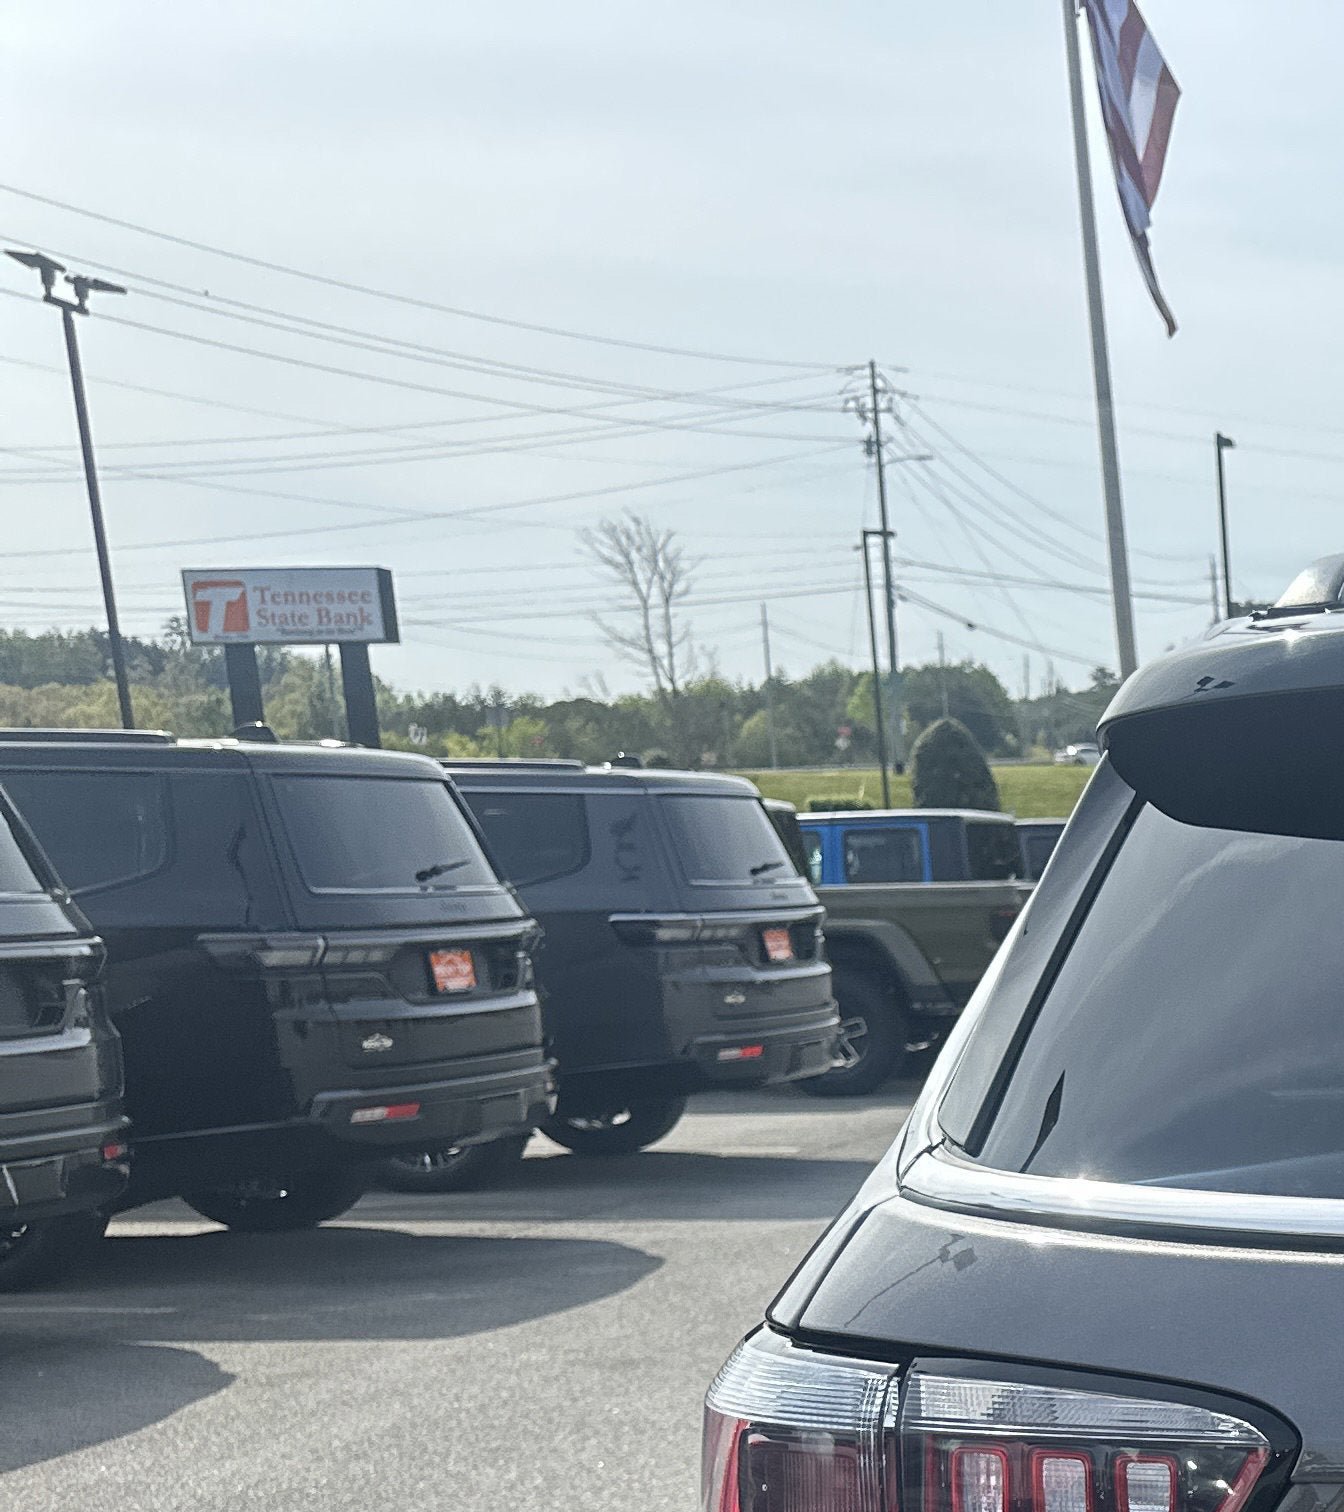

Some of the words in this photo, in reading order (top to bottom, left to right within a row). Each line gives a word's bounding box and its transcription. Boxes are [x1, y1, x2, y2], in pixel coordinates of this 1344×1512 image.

[252, 585, 372, 605] Tennessee
[256, 608, 311, 627] State
[316, 606, 374, 626] Bank
